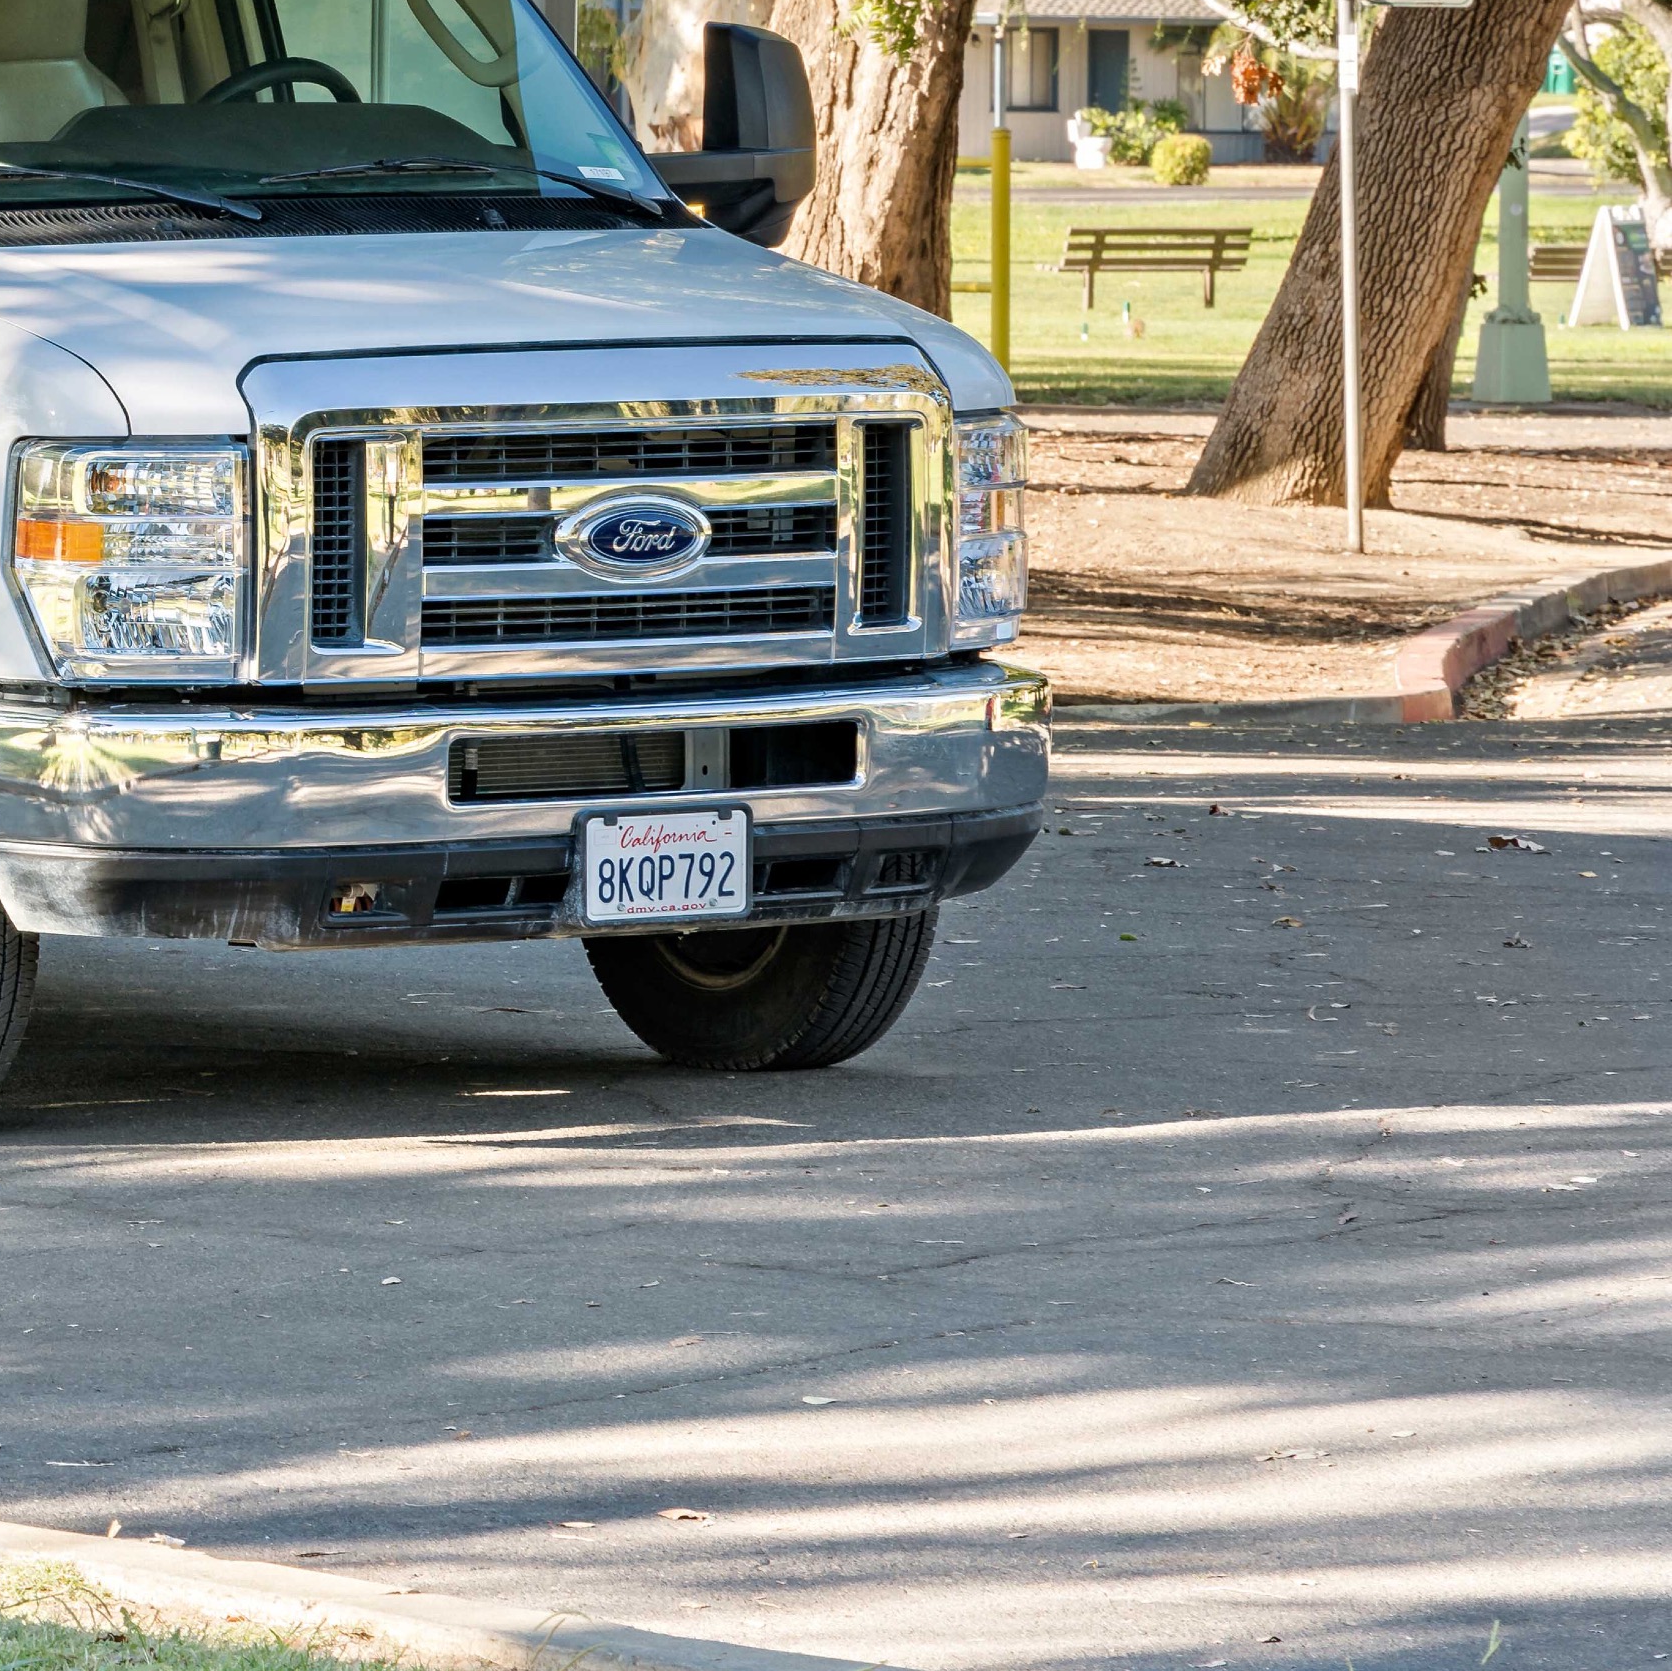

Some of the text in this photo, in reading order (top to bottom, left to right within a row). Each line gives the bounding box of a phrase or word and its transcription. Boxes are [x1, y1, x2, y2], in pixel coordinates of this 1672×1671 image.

[612, 519, 676, 552] Ford
[620, 824, 717, 853] California
[598, 851, 735, 904] 8KQP792
[627, 902, 706, 914] dmv.ca.gov
